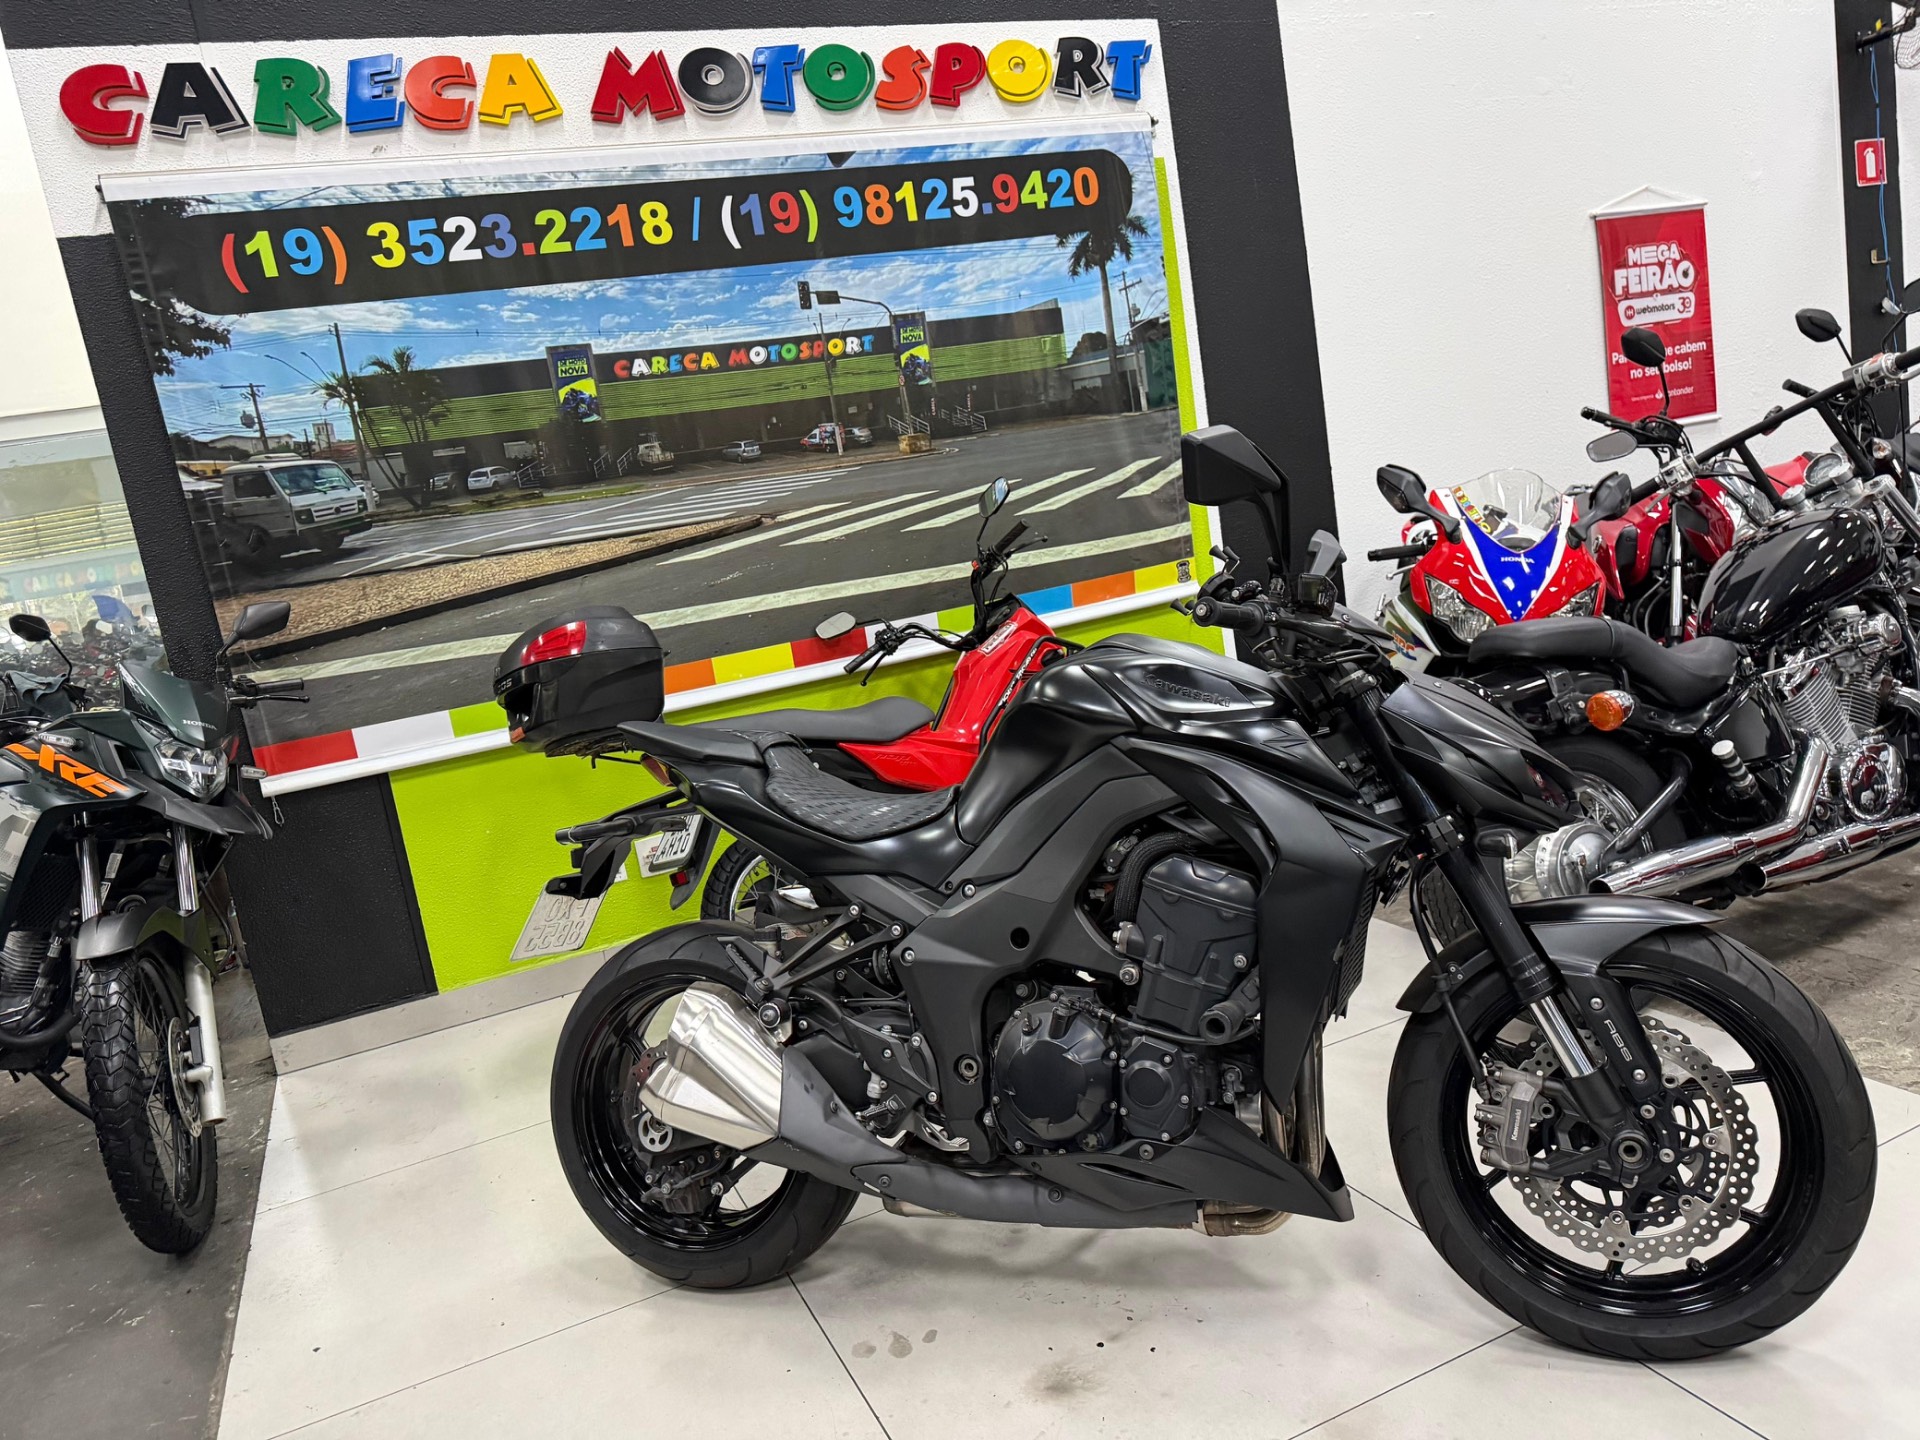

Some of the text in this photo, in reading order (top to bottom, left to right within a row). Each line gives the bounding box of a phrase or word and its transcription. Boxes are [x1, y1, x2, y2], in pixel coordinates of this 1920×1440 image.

[59, 36, 1153, 146] CARECA MOTOSPORT
[221, 226, 348, 293] (19)
[366, 201, 673, 269] 3523.2218
[721, 190, 819, 250] (19)
[836, 167, 1100, 229] 98125.9420
[1627, 242, 1680, 266] MEGA
[1613, 259, 1695, 296] FEIRÃO
[1636, 302, 1676, 315] webmotors
[613, 335, 875, 379] CARECA MOTOSPORT
[1674, 341, 1707, 355] cabem
[560, 366, 586, 377] NOVA
[1630, 368, 1643, 379] no
[1662, 357, 1692, 374] bolso!
[1664, 386, 1694, 398] antander
[1140, 674, 1231, 708] Kawasaki
[182, 719, 218, 731] HONDA
[4, 742, 131, 799] XRE
[1603, 1019, 1633, 1062] ABS
[1510, 1108, 1522, 1141] Kawasaki
